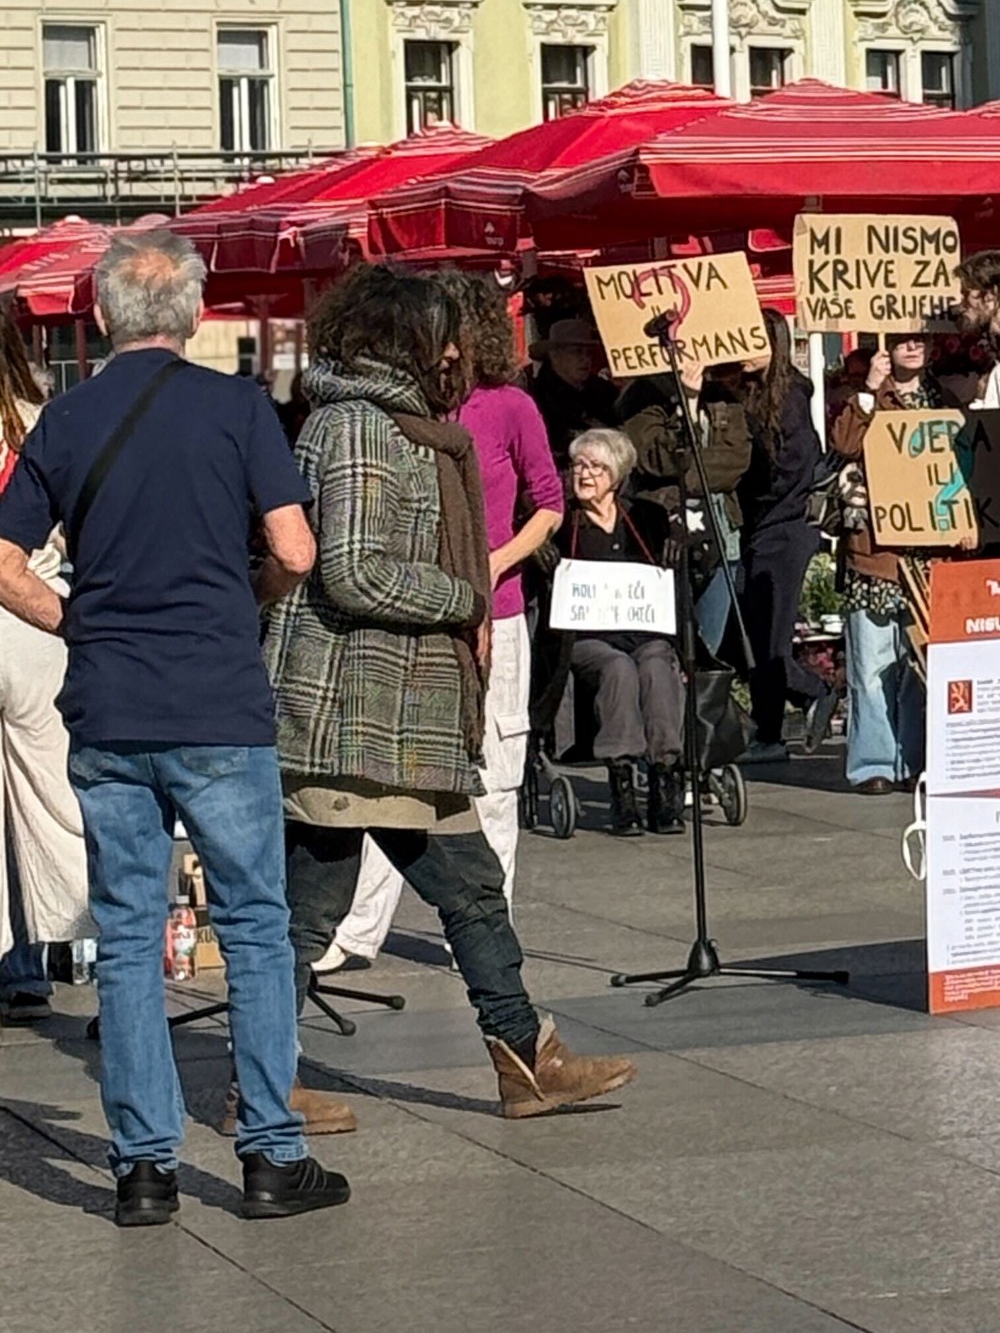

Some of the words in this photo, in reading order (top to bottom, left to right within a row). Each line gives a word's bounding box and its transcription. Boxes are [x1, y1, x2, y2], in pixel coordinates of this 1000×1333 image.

[809, 225, 842, 256] MI
[867, 224, 959, 256] NISMO
[595, 261, 728, 301] MOLITVA
[808, 258, 898, 295] KRIVE
[910, 258, 952, 288] ZA
[805, 290, 857, 322] VAŠE
[869, 293, 959, 322] GRIJEHE
[610, 326, 768, 371] PERFORMANS
[886, 419, 992, 455] VJERA
[926, 461, 956, 487] ILI
